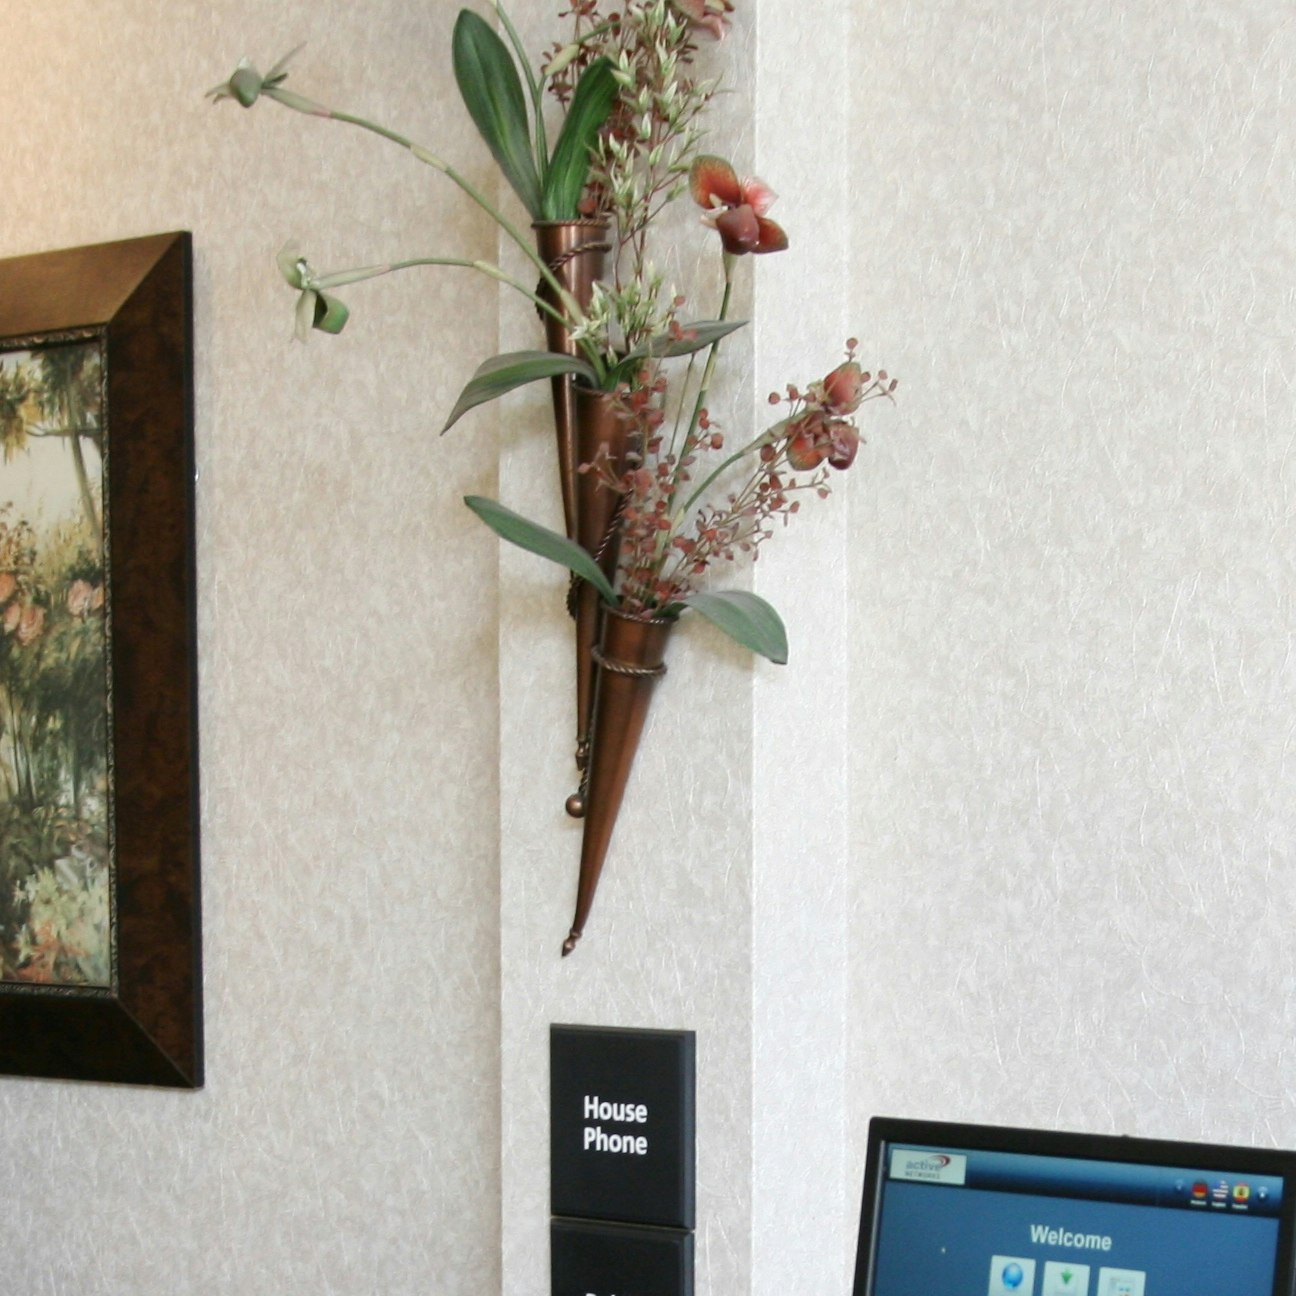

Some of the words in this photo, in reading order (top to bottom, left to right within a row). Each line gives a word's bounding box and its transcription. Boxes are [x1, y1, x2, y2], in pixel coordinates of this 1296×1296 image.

[583, 1095, 648, 1123] House
[583, 1127, 648, 1155] Phone
[905, 1160, 942, 1172] active
[1030, 1224, 1112, 1252] Welcome
